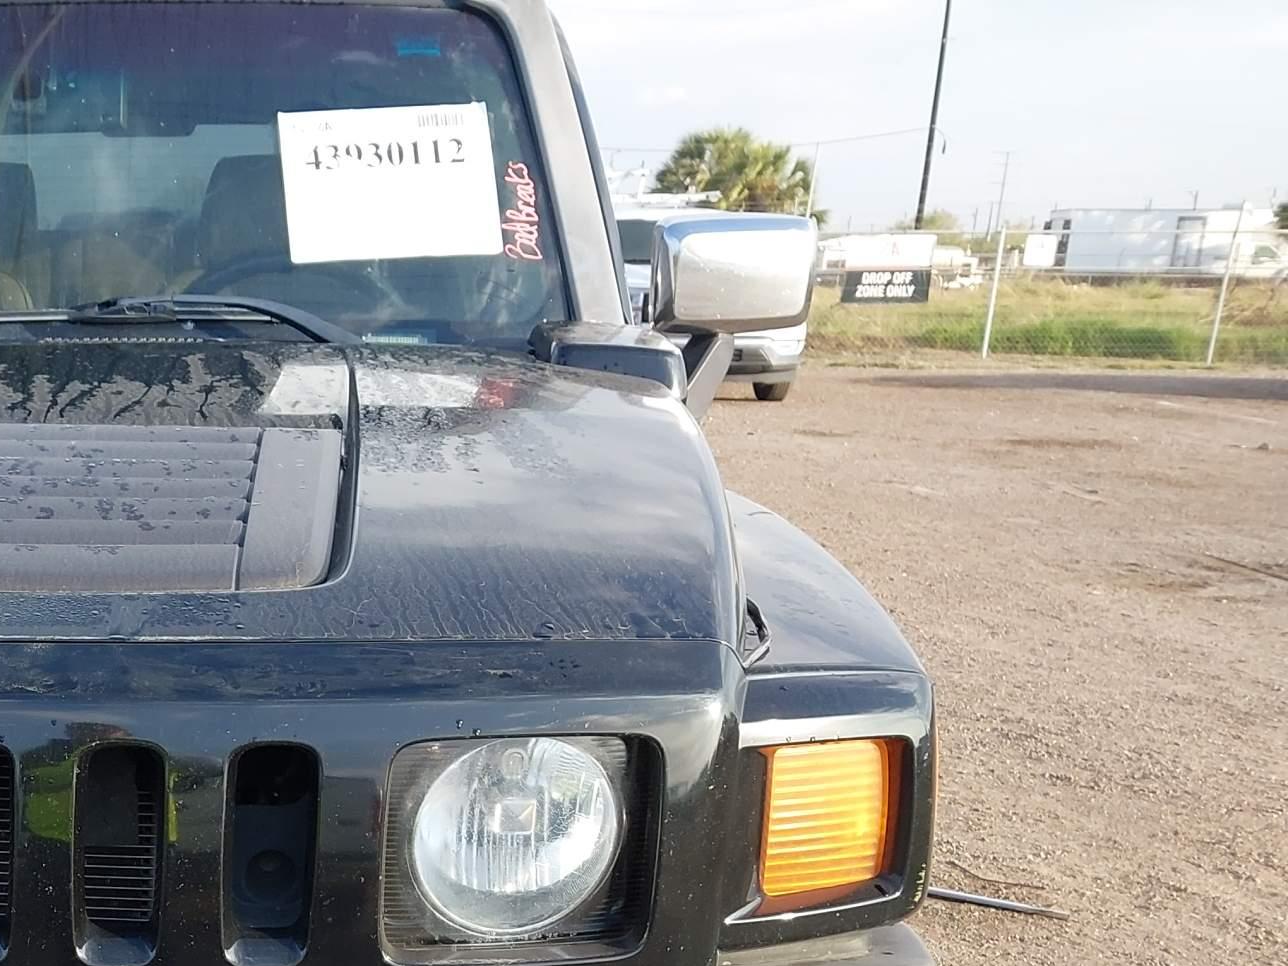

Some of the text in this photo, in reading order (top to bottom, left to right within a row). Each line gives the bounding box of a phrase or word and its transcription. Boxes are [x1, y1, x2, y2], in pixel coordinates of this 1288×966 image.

[304, 138, 466, 171] 43930112
[862, 272, 914, 284] DROP OFF
[855, 284, 916, 297] ZONE ONLY
